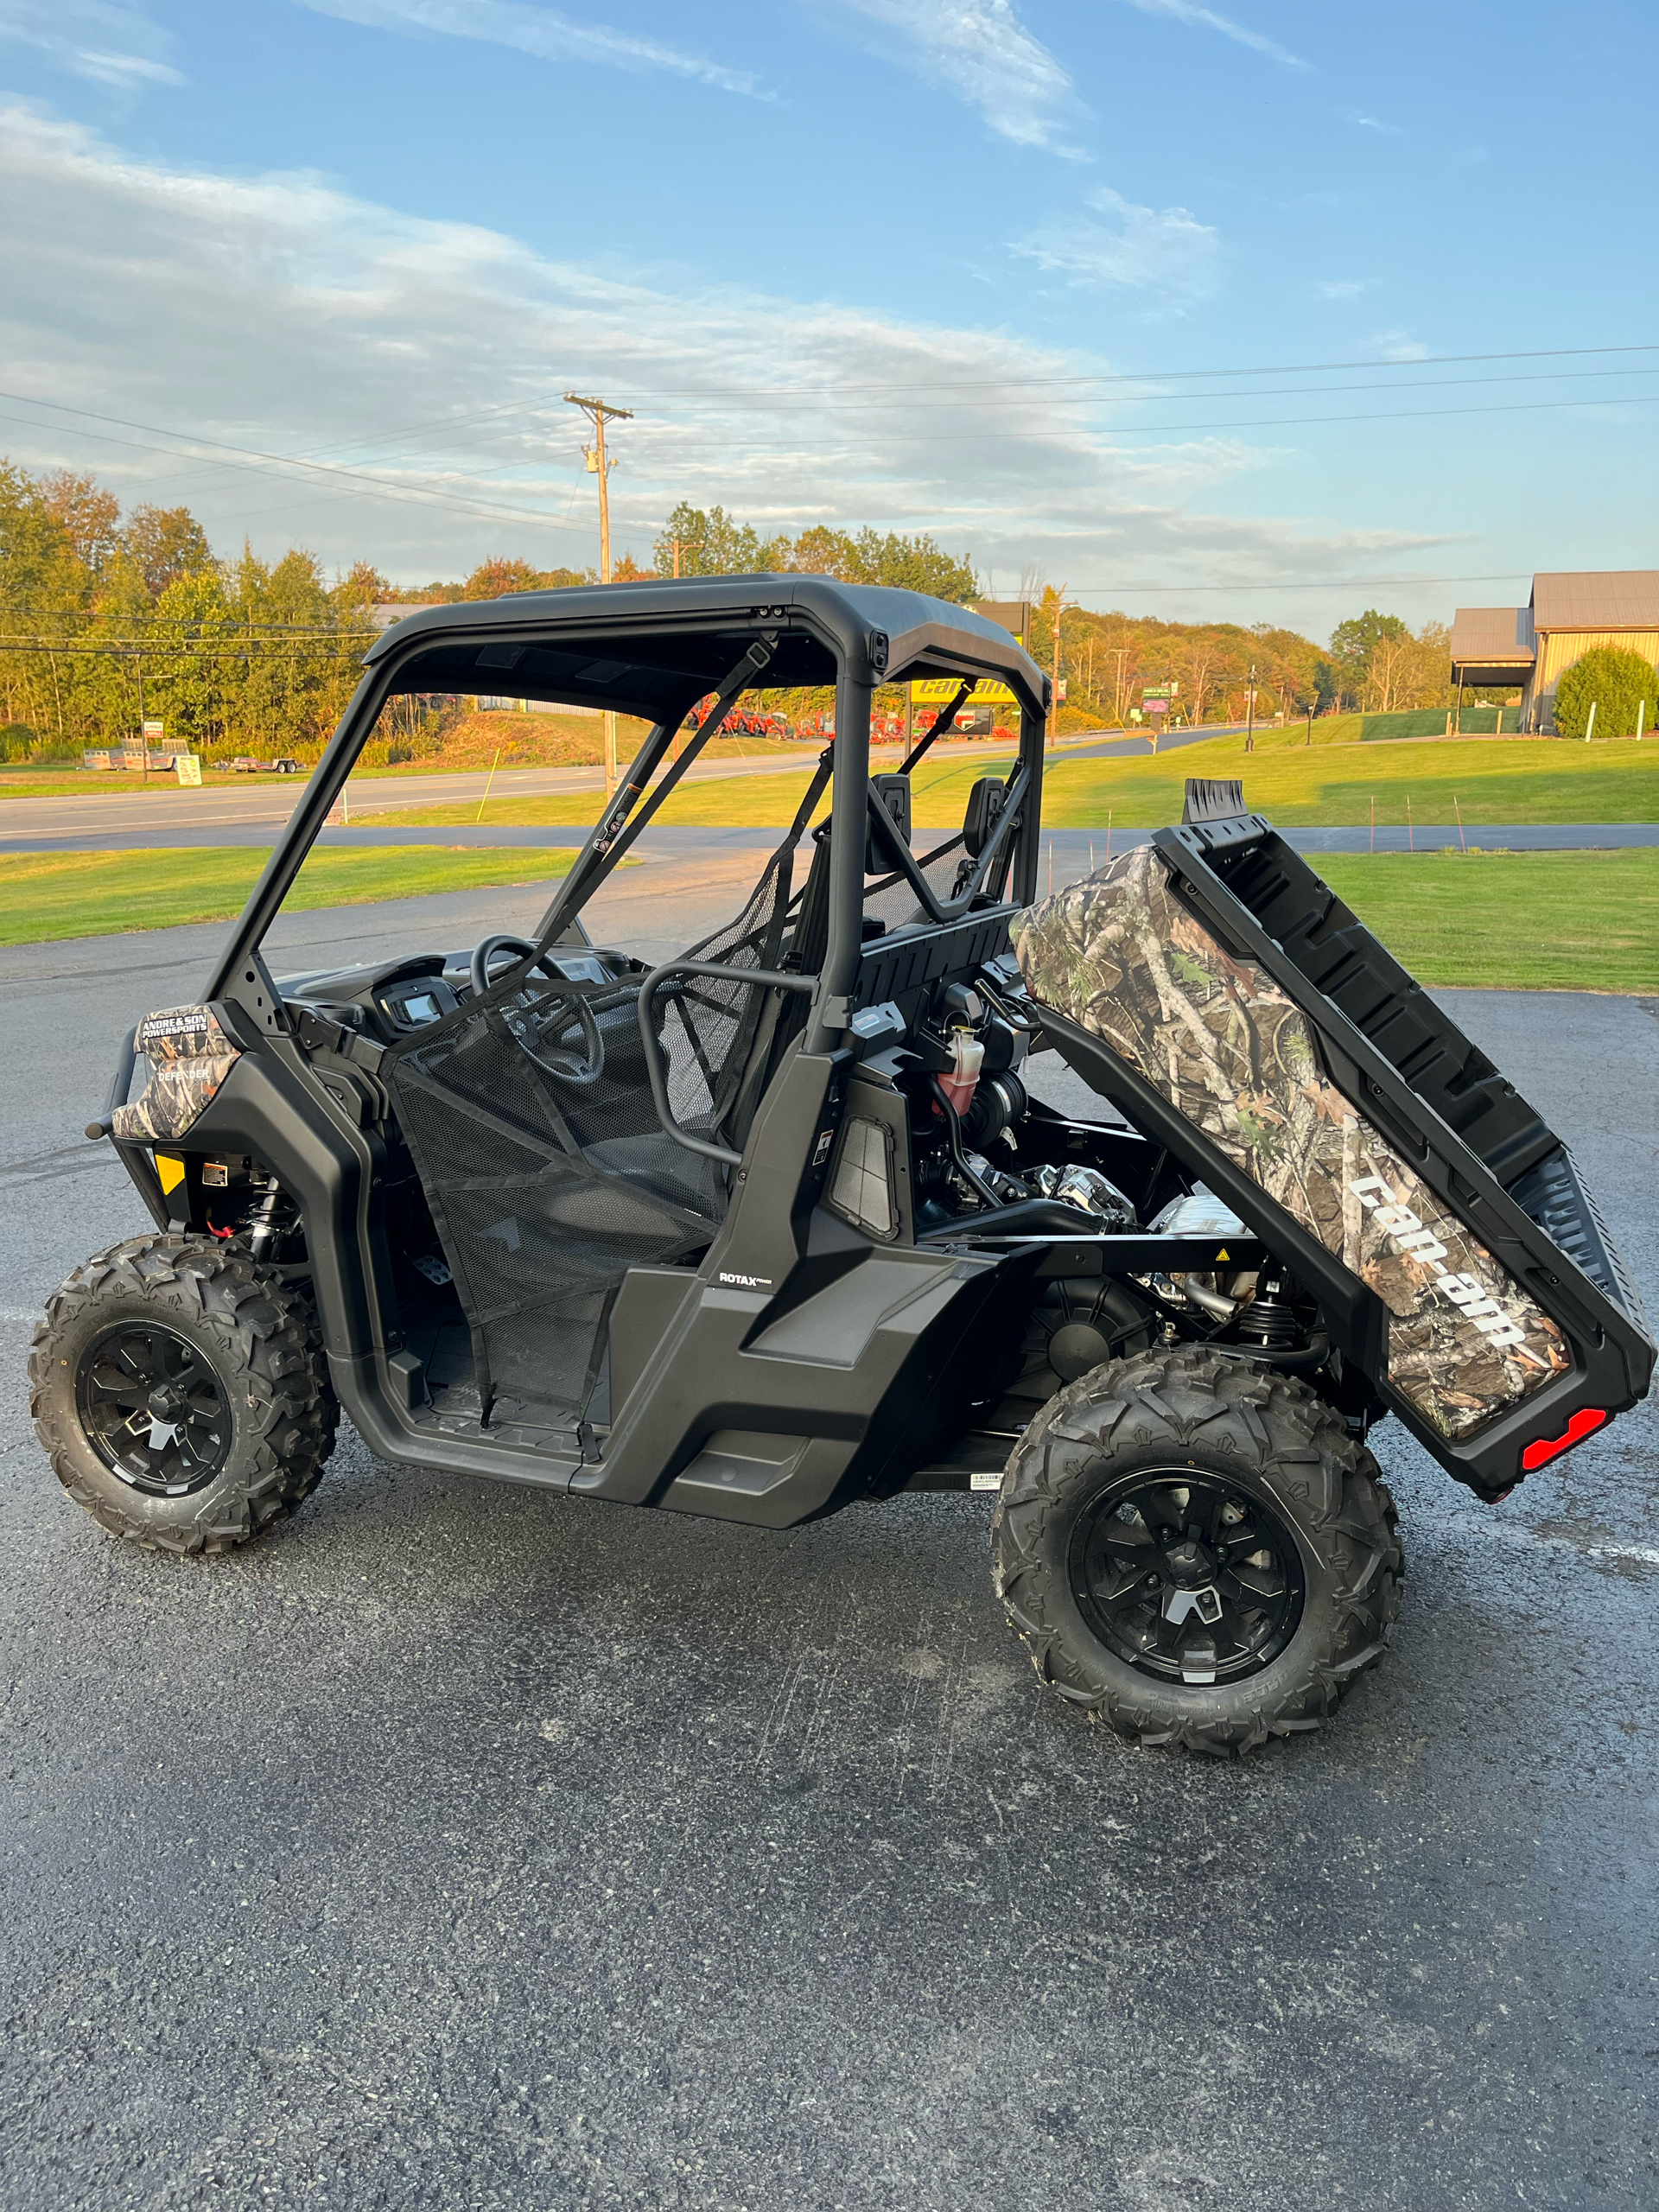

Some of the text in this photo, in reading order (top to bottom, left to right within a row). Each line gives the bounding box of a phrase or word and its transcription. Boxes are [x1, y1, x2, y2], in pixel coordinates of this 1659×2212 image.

[142, 1023, 207, 1039] POWERSPORTS
[158, 1069, 209, 1082] DEFENDER
[719, 1272, 757, 1287] ROTAX
